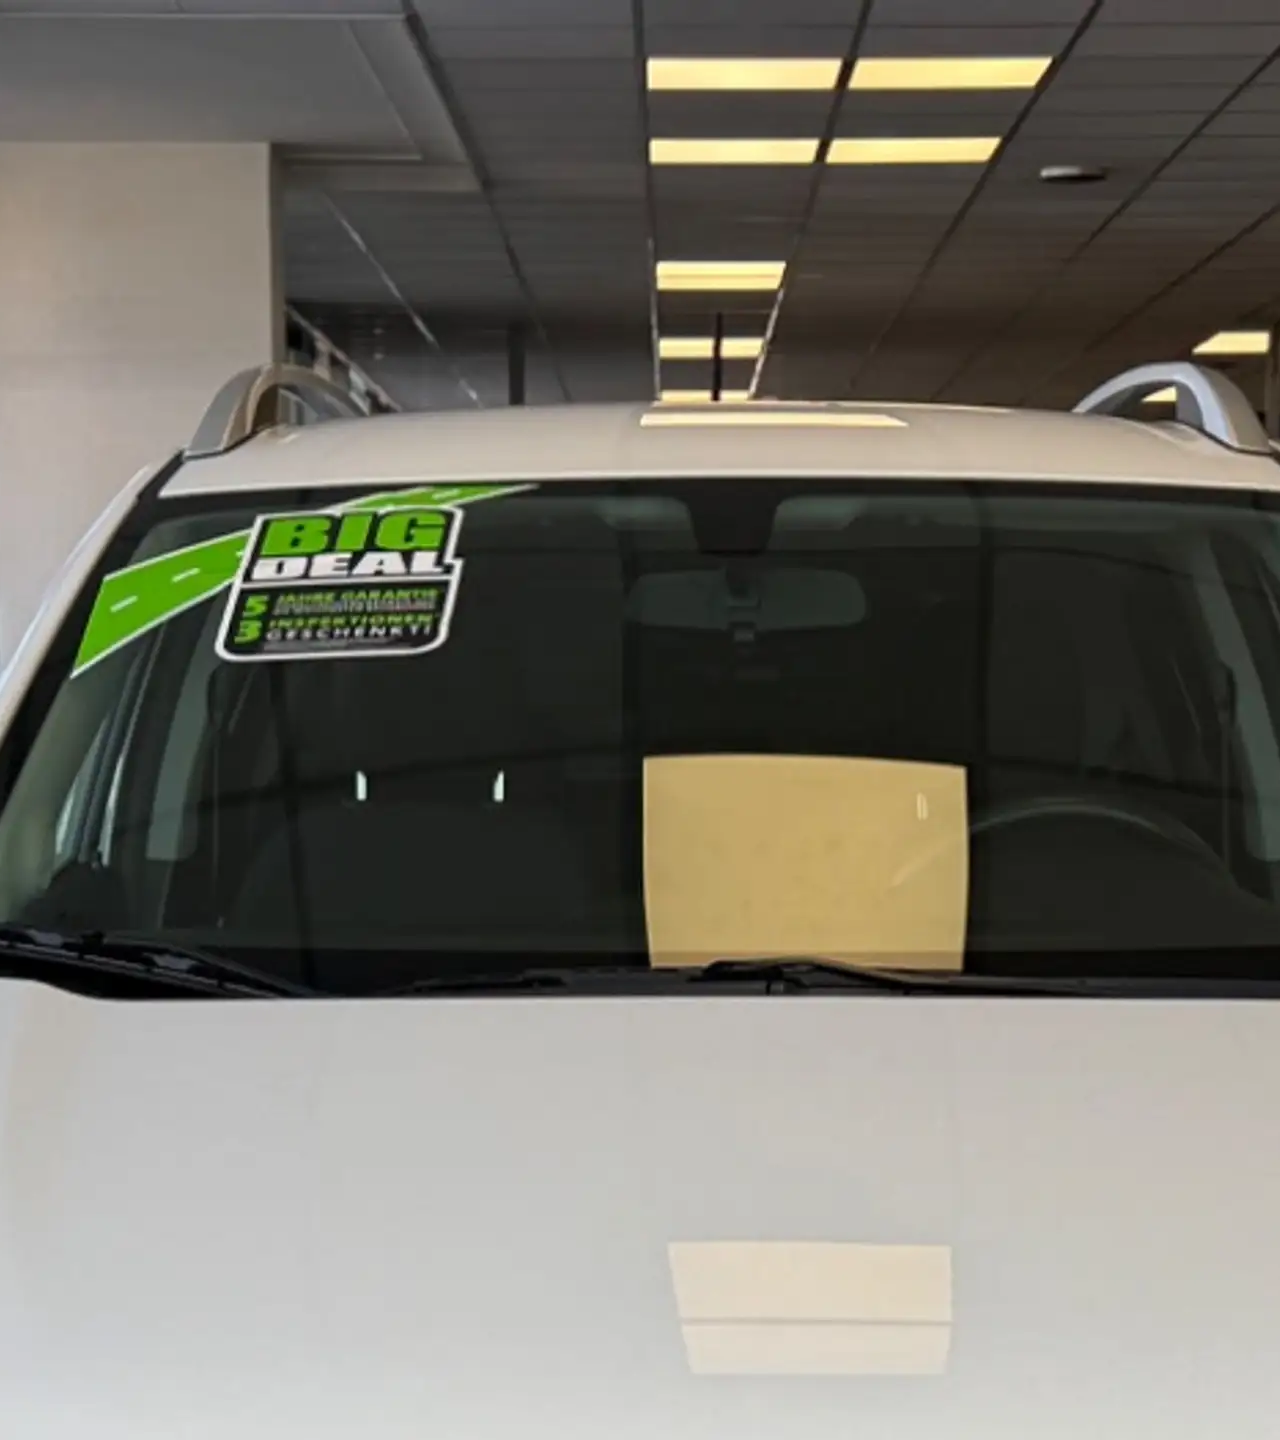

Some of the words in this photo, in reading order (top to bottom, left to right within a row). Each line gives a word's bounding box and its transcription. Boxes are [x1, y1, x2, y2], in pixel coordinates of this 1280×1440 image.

[260, 510, 448, 555] BIG
[250, 551, 455, 581] DEAL
[243, 593, 271, 617] 5
[234, 619, 263, 644] 3
[268, 613, 435, 629] INSPEKTIONEN
